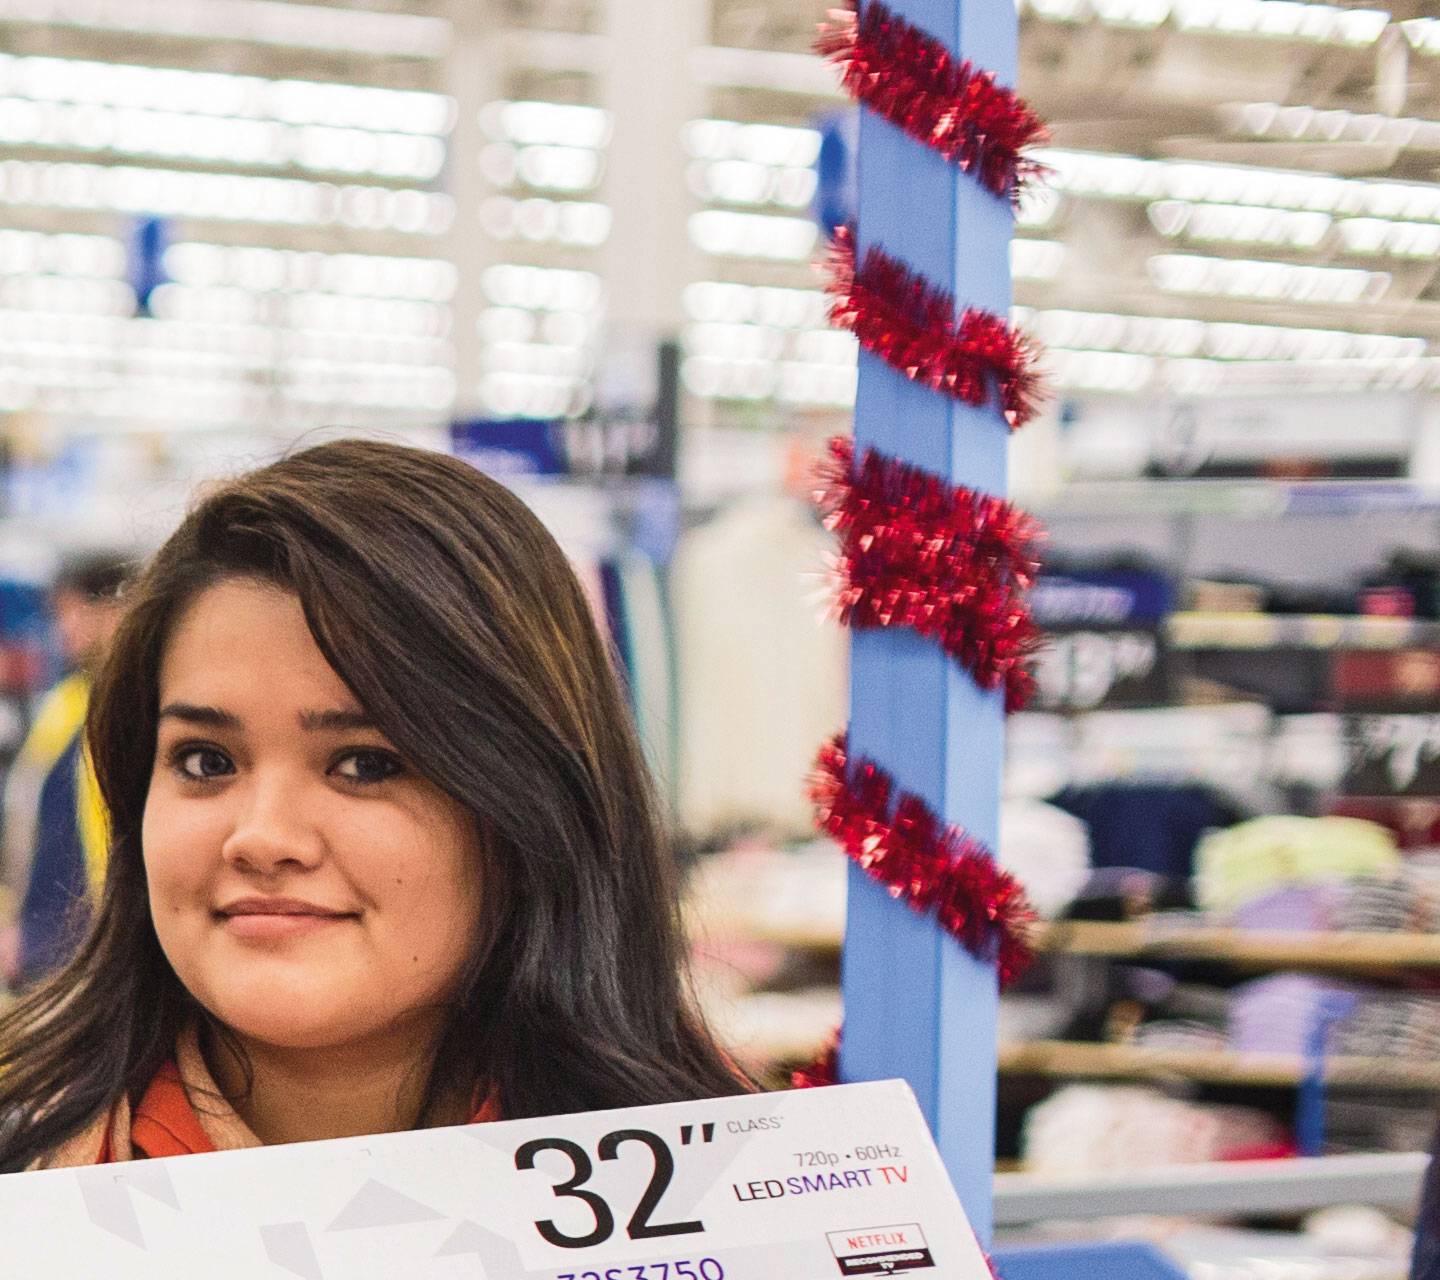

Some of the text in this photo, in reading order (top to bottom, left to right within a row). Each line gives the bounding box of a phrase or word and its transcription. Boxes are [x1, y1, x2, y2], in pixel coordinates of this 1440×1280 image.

[793, 1143, 902, 1169] 720p 60Hz
[877, 1165, 909, 1185] TV
[846, 1232, 908, 1250] NETFLIX
